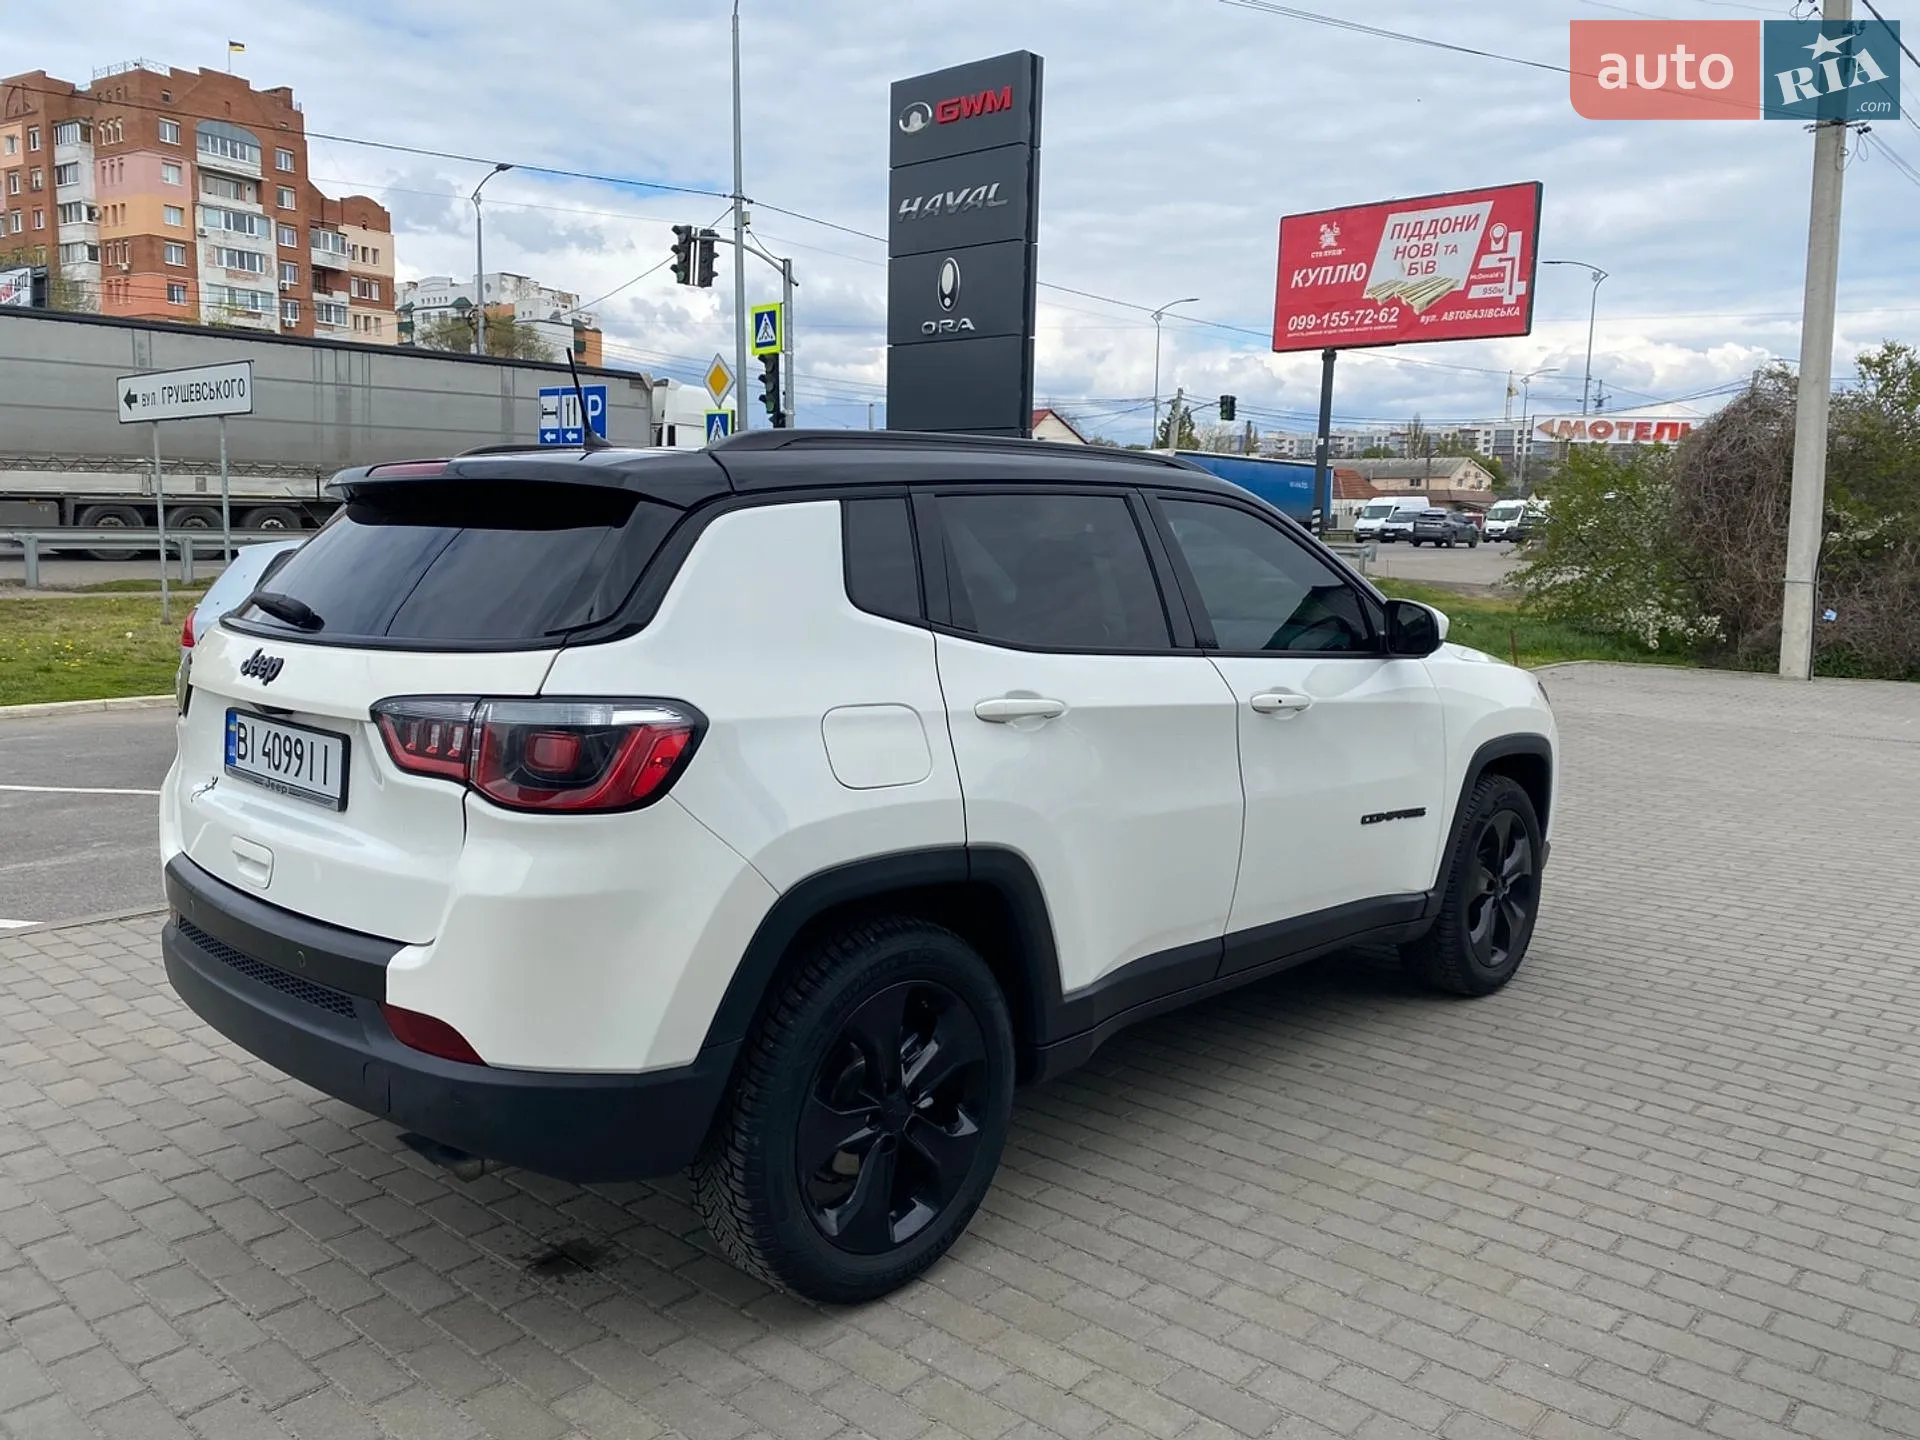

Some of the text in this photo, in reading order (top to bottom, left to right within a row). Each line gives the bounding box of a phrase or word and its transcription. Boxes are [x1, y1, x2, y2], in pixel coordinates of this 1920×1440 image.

[936, 86, 1013, 124] GWM
[898, 182, 1008, 222] HAVAL
[1390, 213, 1480, 242] ПІДДОНИ
[1394, 241, 1439, 260] НОВІ
[1290, 262, 1367, 289] КУПЛЮ
[921, 317, 975, 335] ORA
[161, 378, 246, 404] ГРУШЕВСЬКОГО
[240, 647, 284, 686] Jeep
